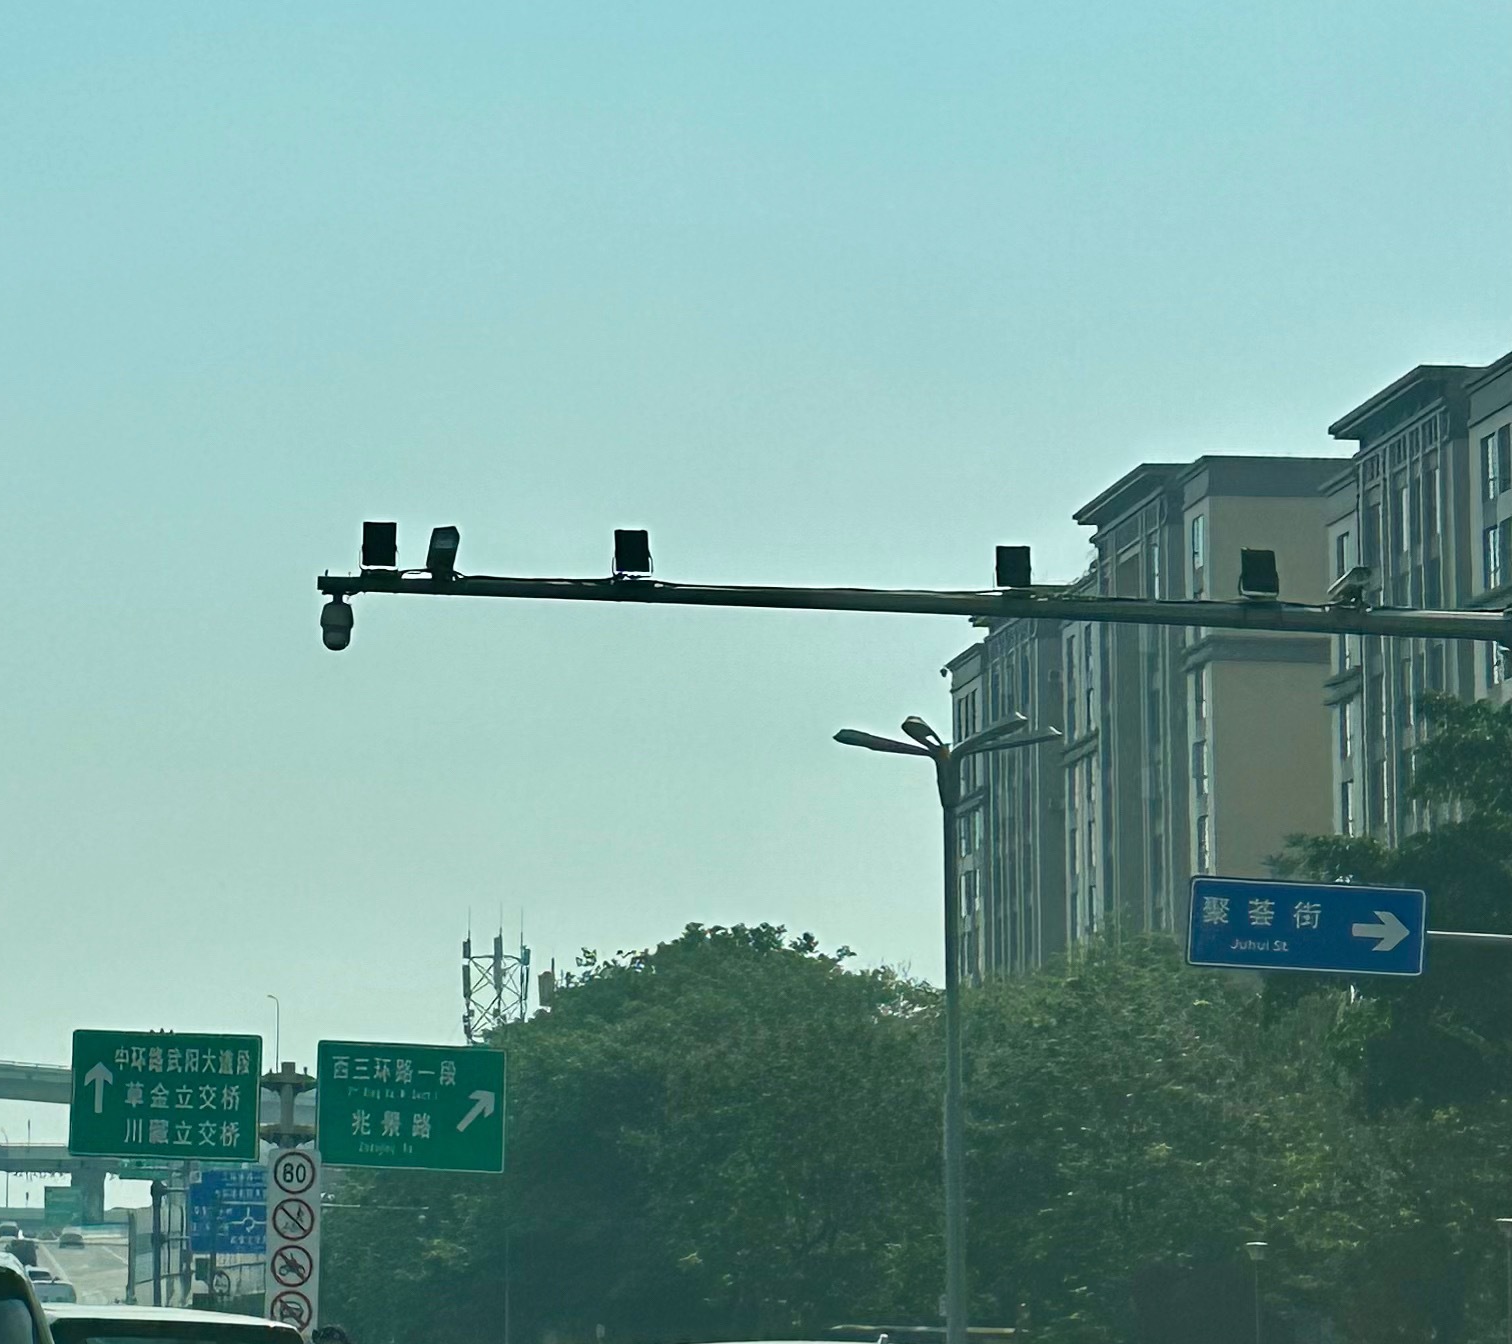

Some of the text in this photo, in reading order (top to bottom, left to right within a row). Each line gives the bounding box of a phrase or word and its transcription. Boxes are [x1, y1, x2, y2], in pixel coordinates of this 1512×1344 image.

[1230, 938, 1269, 951] Juhui
[332, 1056, 456, 1086] 西三环路一段
